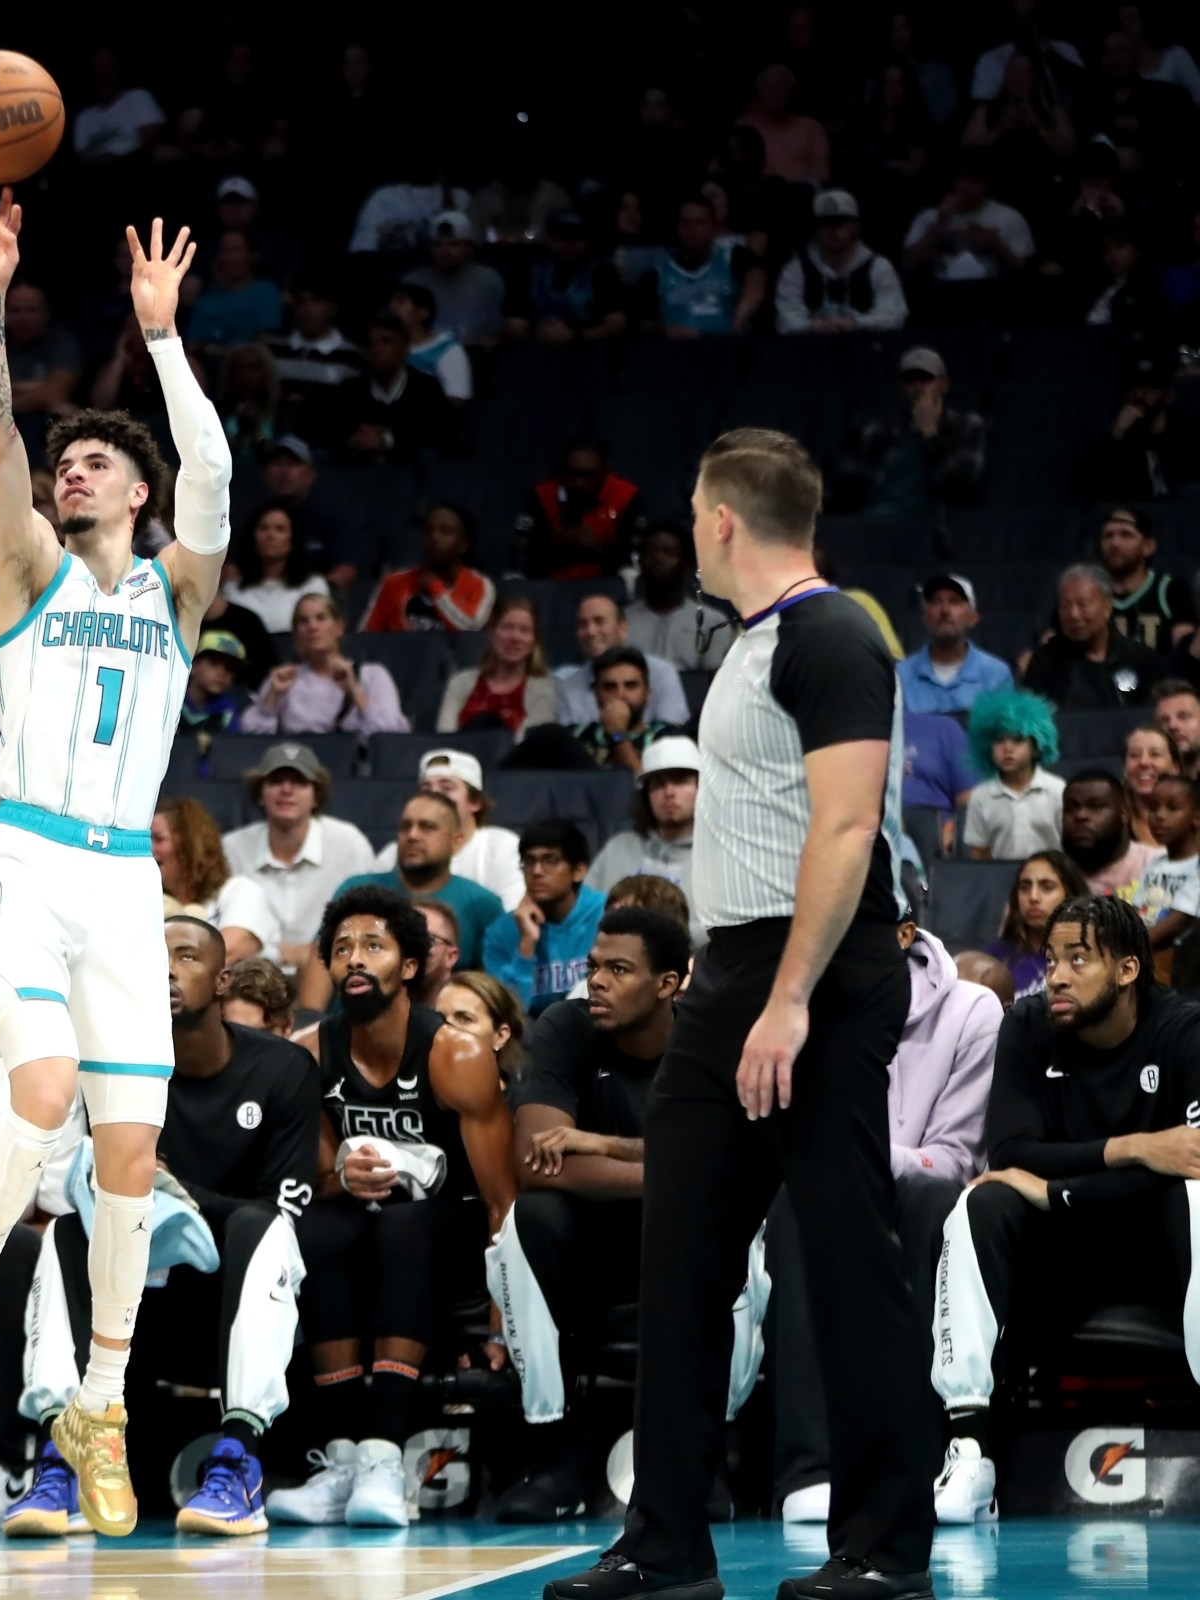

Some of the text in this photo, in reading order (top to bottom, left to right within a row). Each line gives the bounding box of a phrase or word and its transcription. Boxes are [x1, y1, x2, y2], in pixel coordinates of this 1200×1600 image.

[41, 611, 170, 661] CHARLOTTE
[92, 665, 125, 746] 1
[341, 1105, 426, 1144] ETS
[941, 1240, 954, 1367] BROOKLYN NETS
[1064, 1427, 1146, 1505] G
